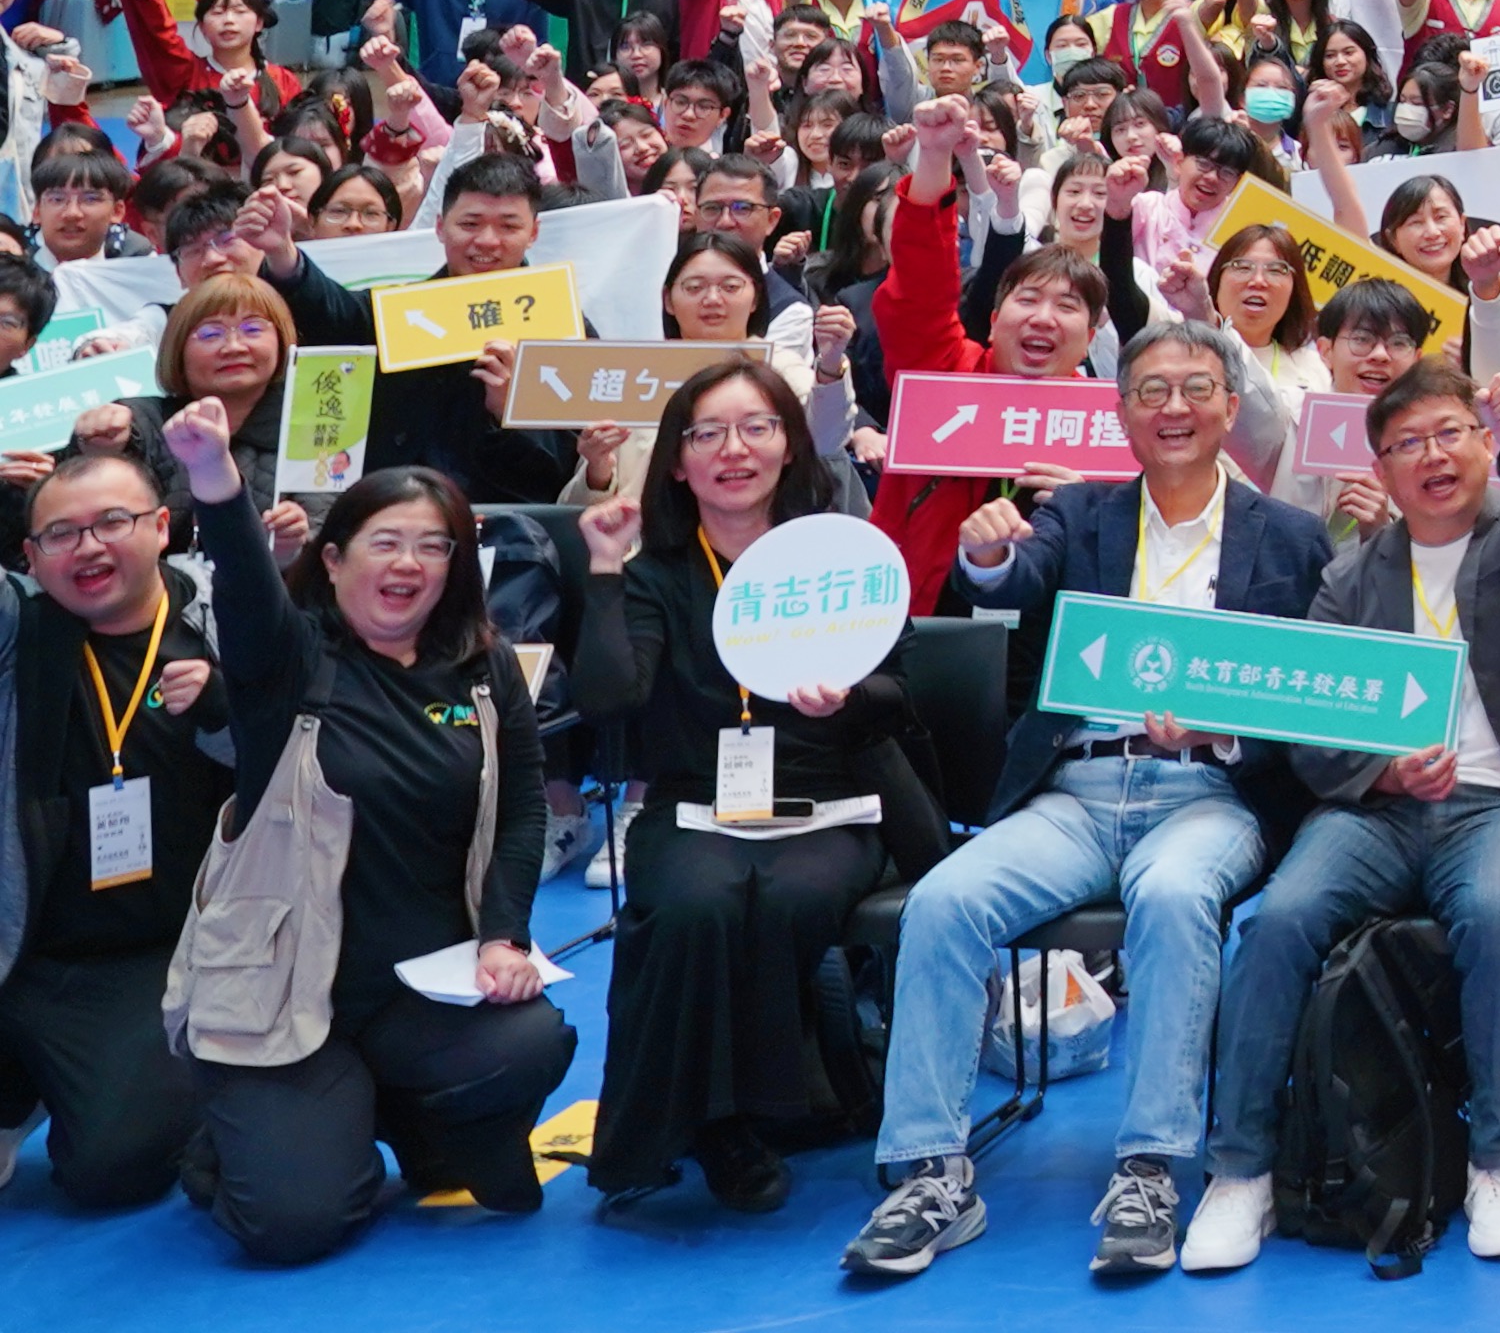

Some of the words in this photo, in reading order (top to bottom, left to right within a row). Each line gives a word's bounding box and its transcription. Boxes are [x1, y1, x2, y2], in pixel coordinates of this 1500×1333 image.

[728, 563, 900, 625] 青志行動
[1185, 657, 1384, 702] 教育部青年發展署
